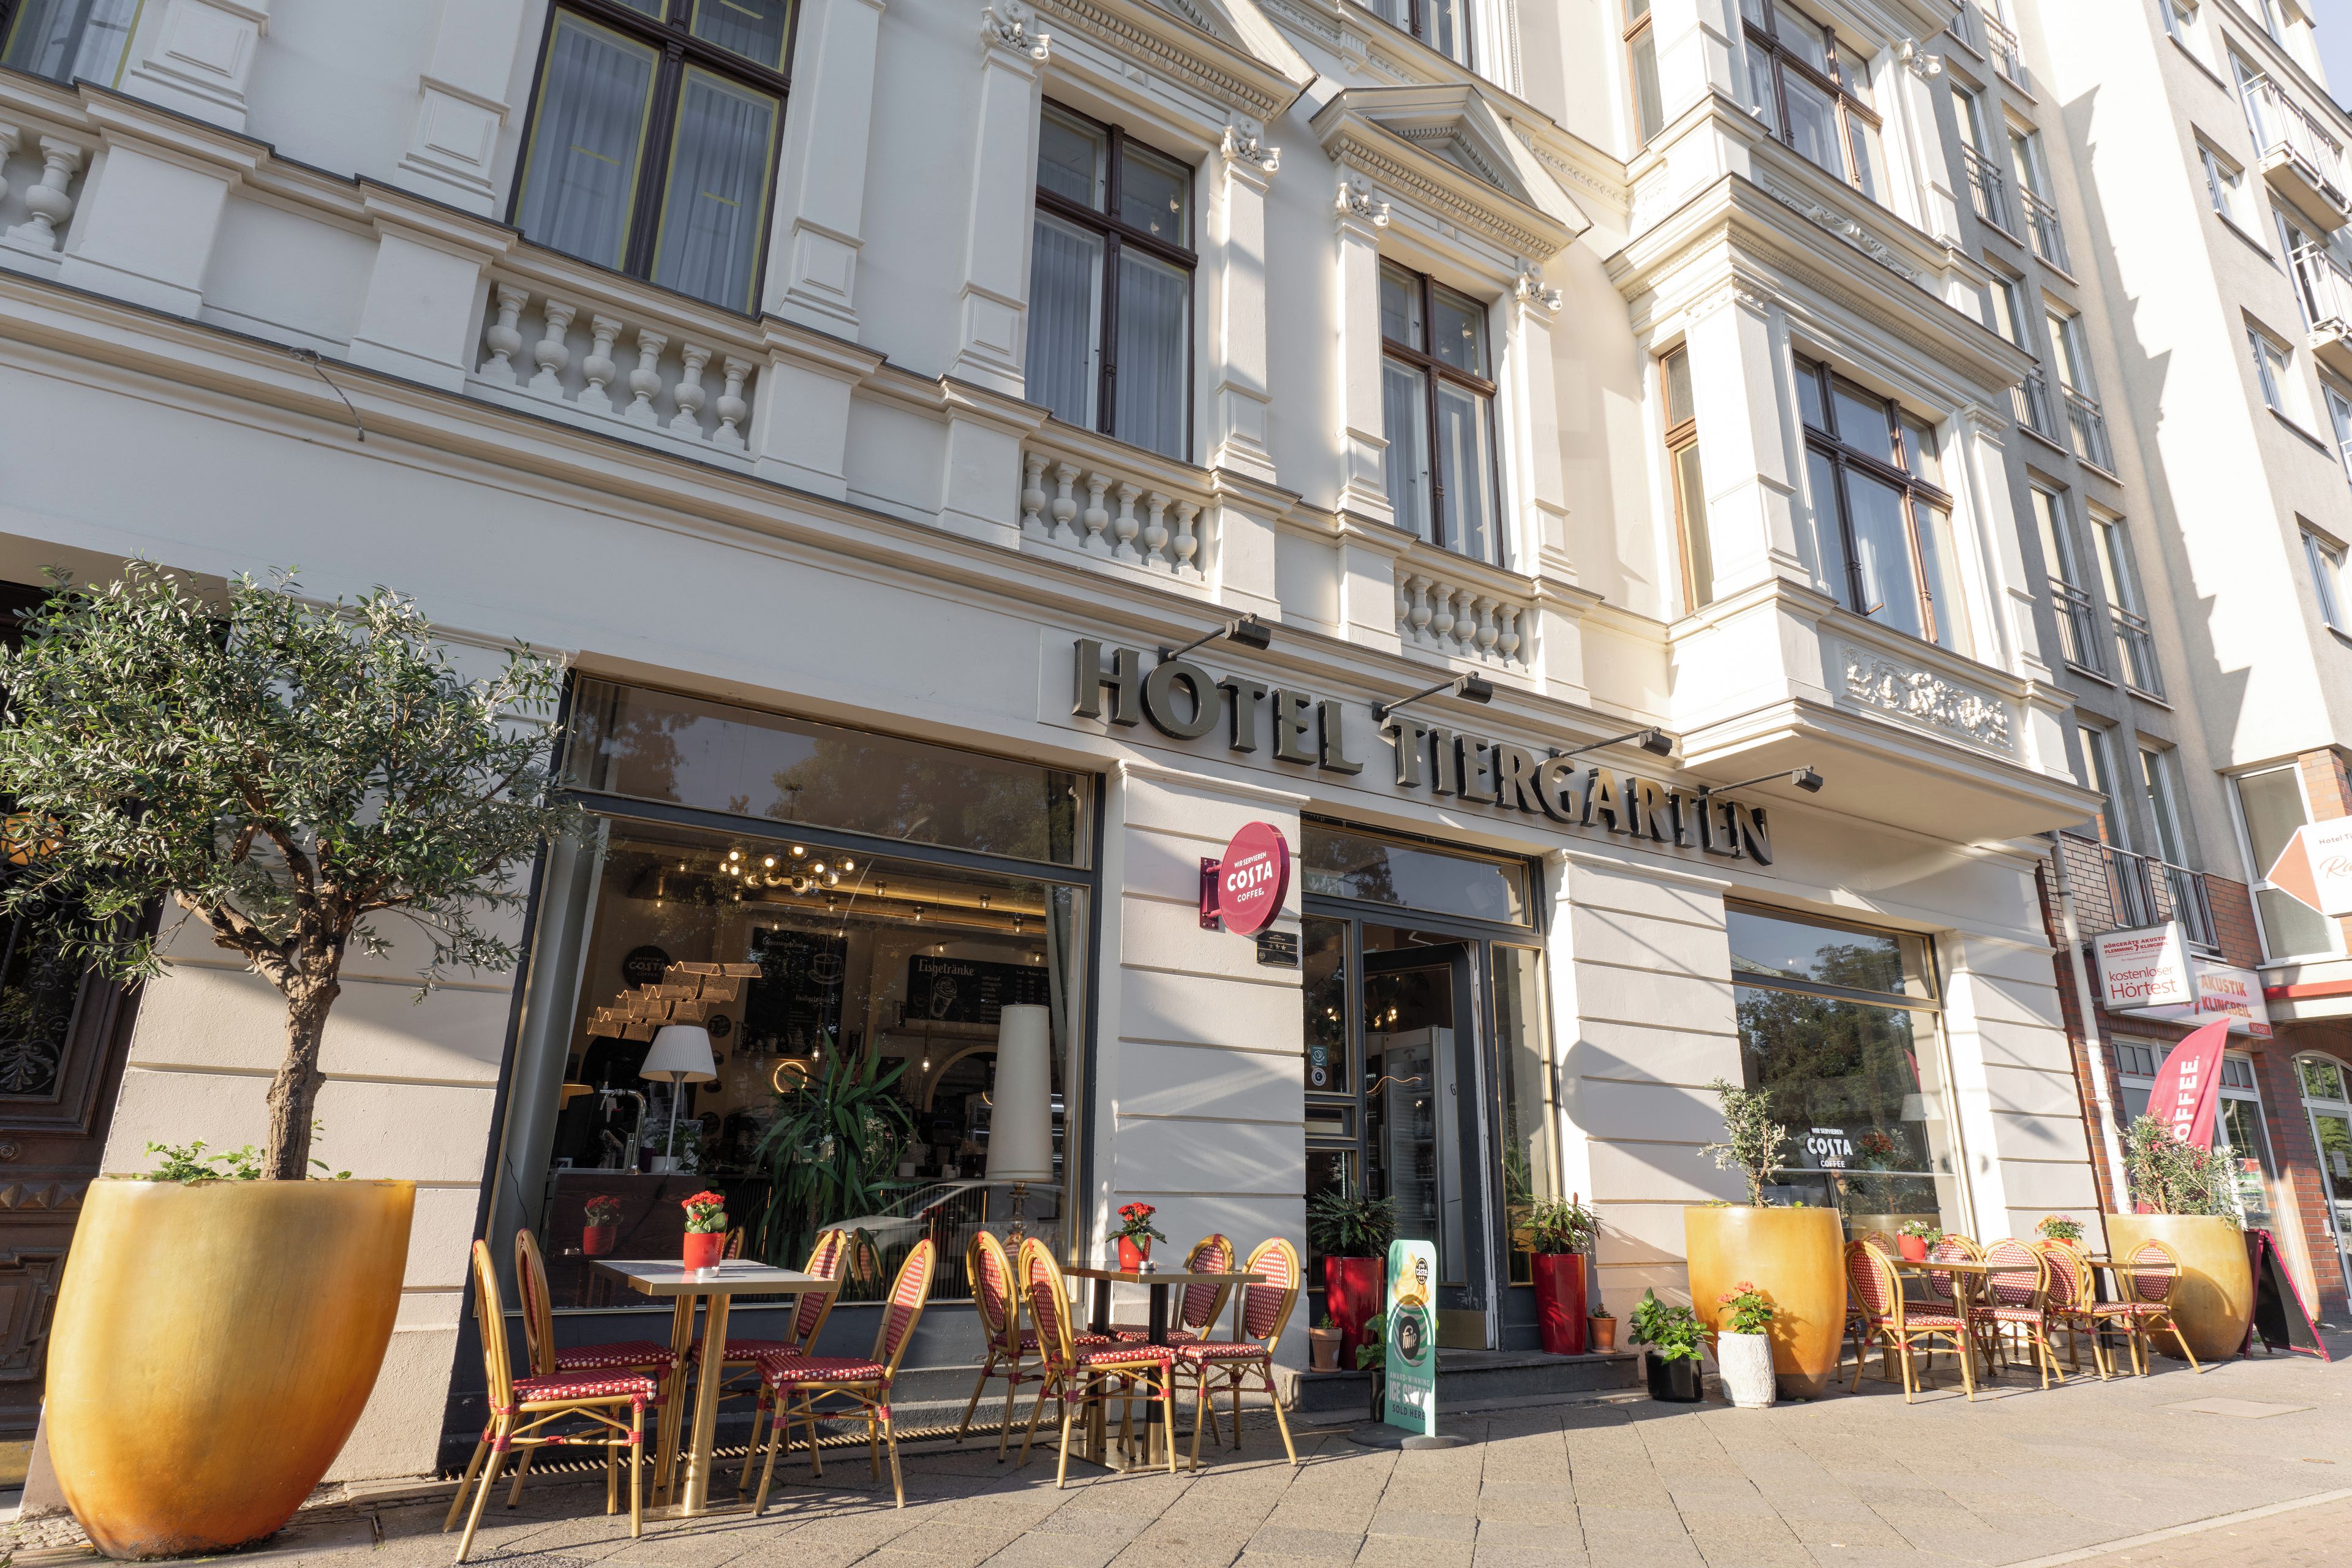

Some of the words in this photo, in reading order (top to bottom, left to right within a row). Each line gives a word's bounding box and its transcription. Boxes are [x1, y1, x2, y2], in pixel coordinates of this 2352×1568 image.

[1071, 638, 1363, 776] HOTEL
[1380, 715, 1773, 867] TIERGARTEN
[2319, 835, 2342, 845] Hotel
[1243, 851, 1267, 865] SERVIEREN
[1227, 861, 1273, 892] COSTA
[2104, 940, 2139, 949] HÖRGERÄTE
[918, 959, 976, 976] Eisgetränke
[2109, 967, 2173, 982] kostenloser
[2111, 979, 2177, 999] Hörtest
[2201, 974, 2247, 997] AKUSTIK
[2201, 996, 2252, 1018] KLINGBEIL
[2252, 1024, 2268, 1035] MOABIT
[1807, 1137, 1853, 1157] COSTA
[1389, 1380, 1401, 1402] ICE
[1403, 1384, 1430, 1409] CRA
[1392, 1404, 1408, 1415] SOLD
[1410, 1408, 1426, 1420] HERE
